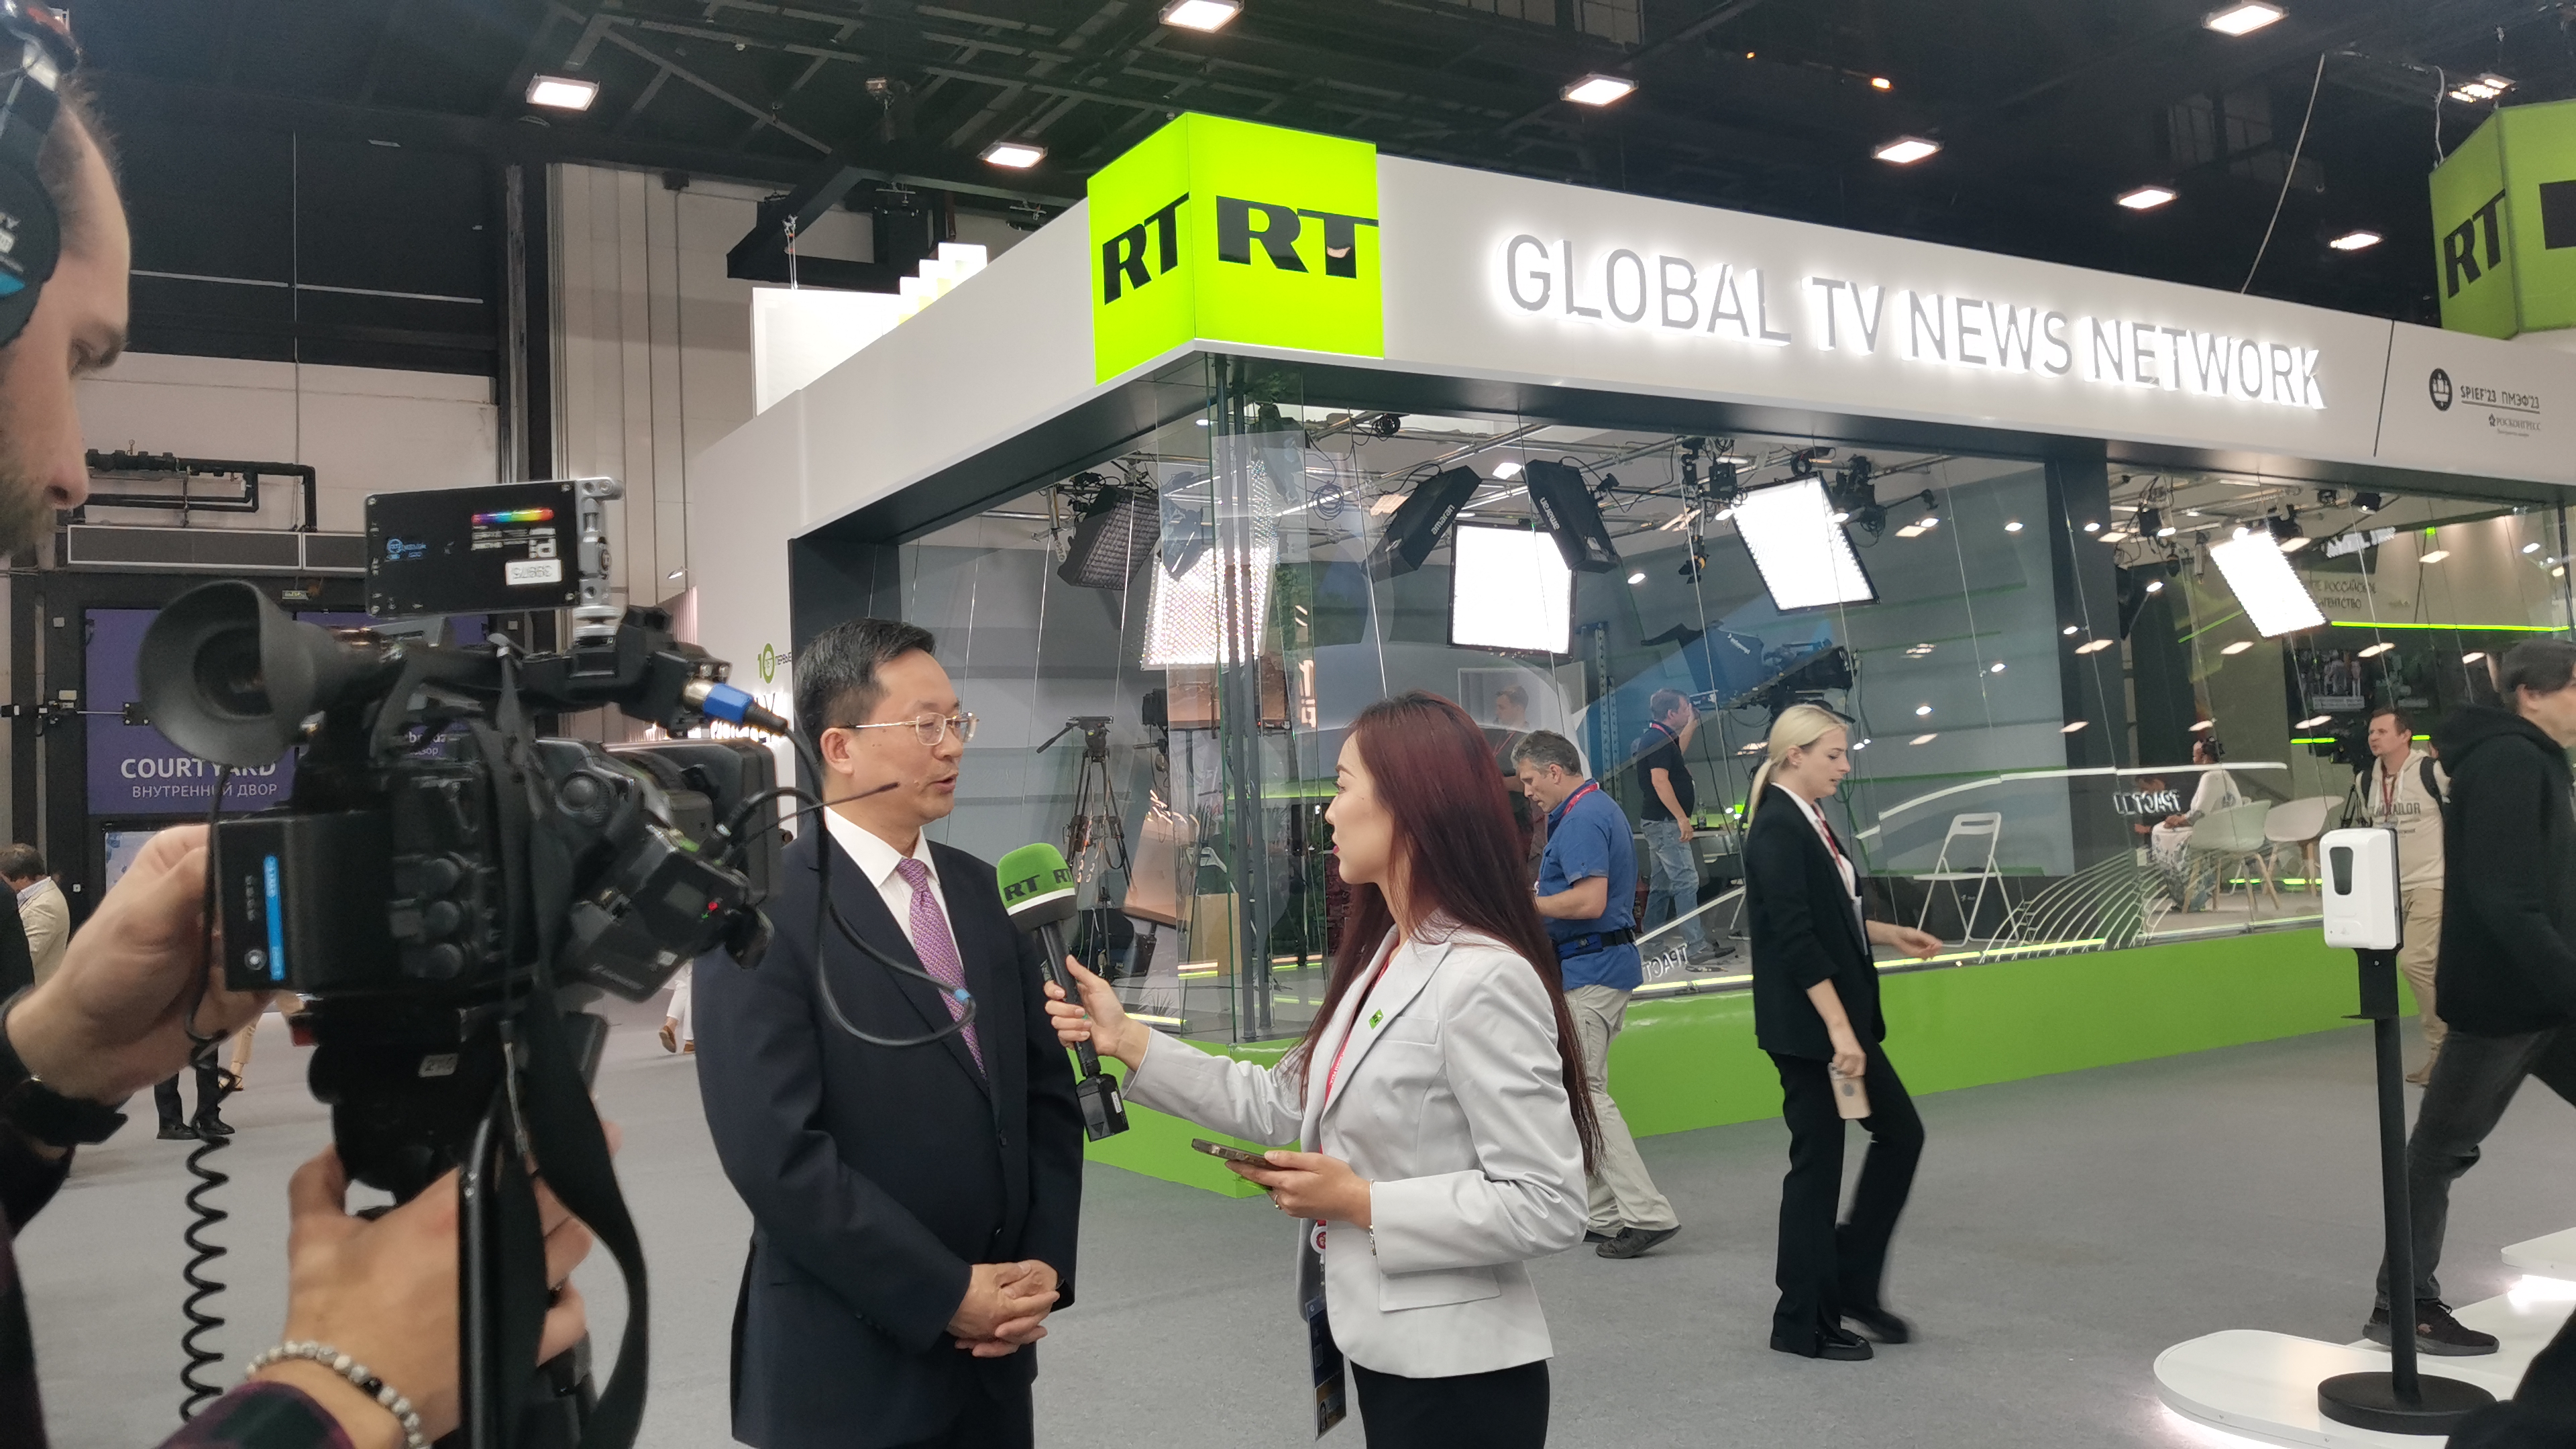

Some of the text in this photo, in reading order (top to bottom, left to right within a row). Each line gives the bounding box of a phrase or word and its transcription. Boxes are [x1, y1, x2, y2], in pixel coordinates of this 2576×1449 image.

[1102, 192, 1189, 306] RT
[1216, 195, 1379, 279] RT
[2443, 188, 2506, 299] RT
[1503, 233, 2328, 410] GLOBAL TV NEWS NETWORK
[2460, 385, 2497, 403] SPIEF'23
[1430, 504, 1455, 535] amaran
[1540, 497, 1560, 531] amaran
[237, 784, 278, 798] ДВОР
[1004, 874, 1040, 902] RT
